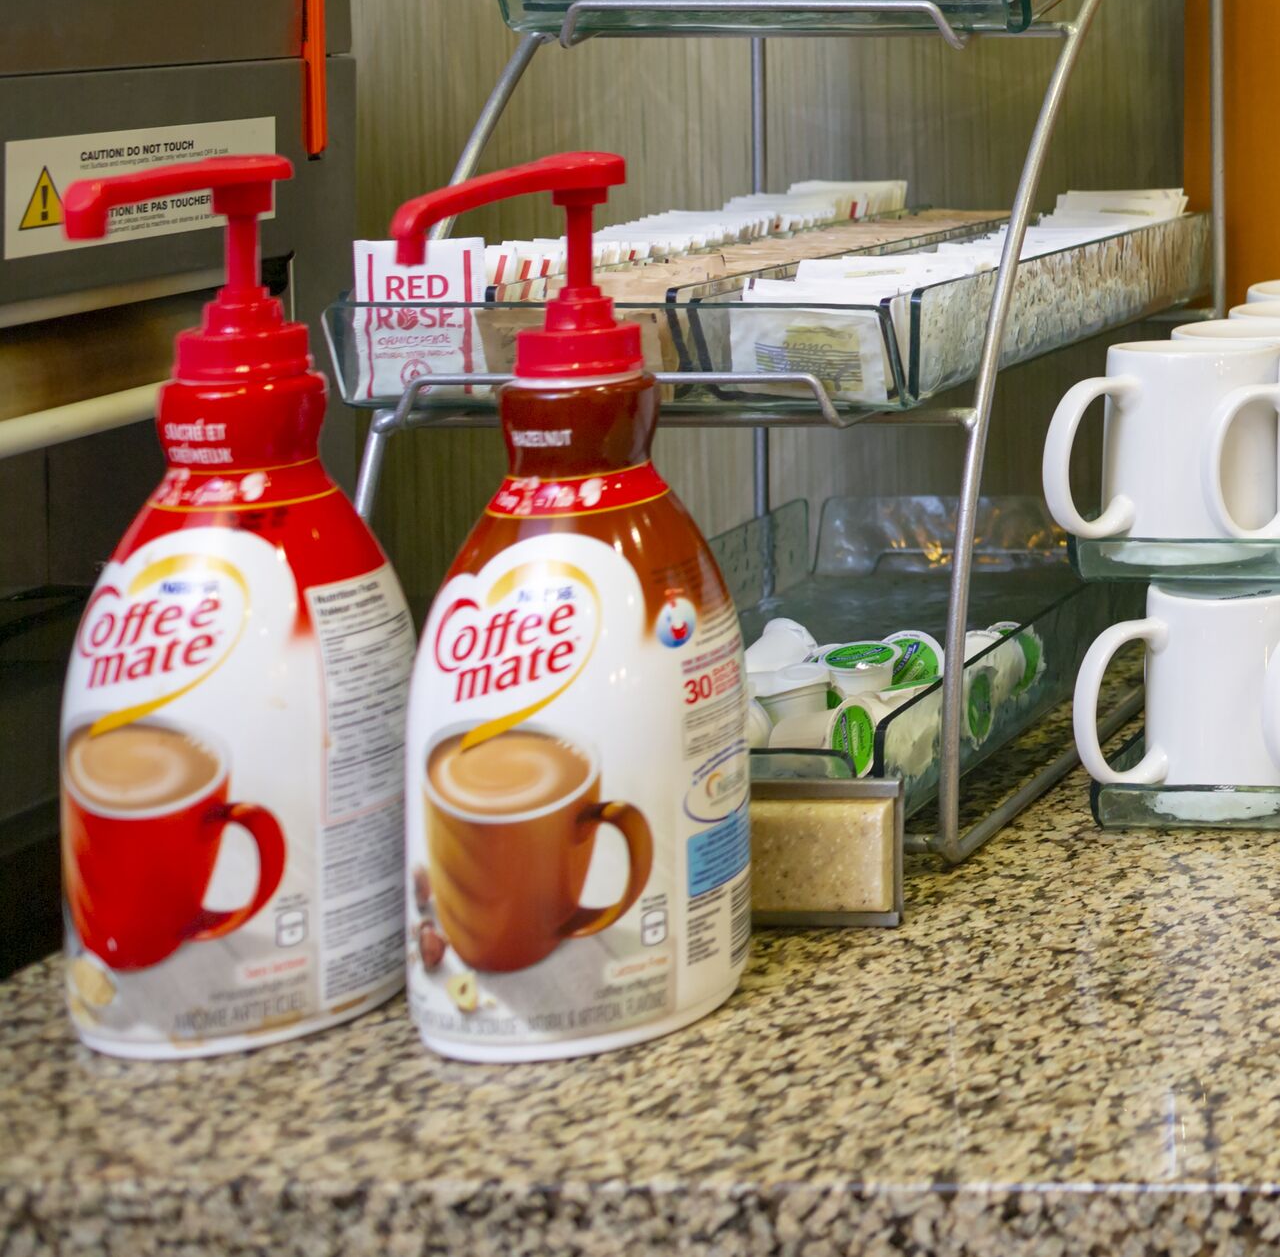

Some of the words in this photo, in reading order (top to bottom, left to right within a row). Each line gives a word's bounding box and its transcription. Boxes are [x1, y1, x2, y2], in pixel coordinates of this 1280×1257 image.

[80, 147, 125, 162] CAUTION!
[127, 145, 140, 156] DO
[143, 144, 161, 155] NOT
[164, 140, 194, 153] TOUCH
[136, 203, 149, 214] NE
[151, 200, 168, 212] PAS
[385, 274, 449, 301] RED
[206, 423, 227, 441] ET
[77, 584, 222, 659] Coffee
[433, 597, 577, 673] Coffee
[87, 632, 215, 690] mate
[453, 638, 575, 704] mate
[684, 674, 712, 705] 30
